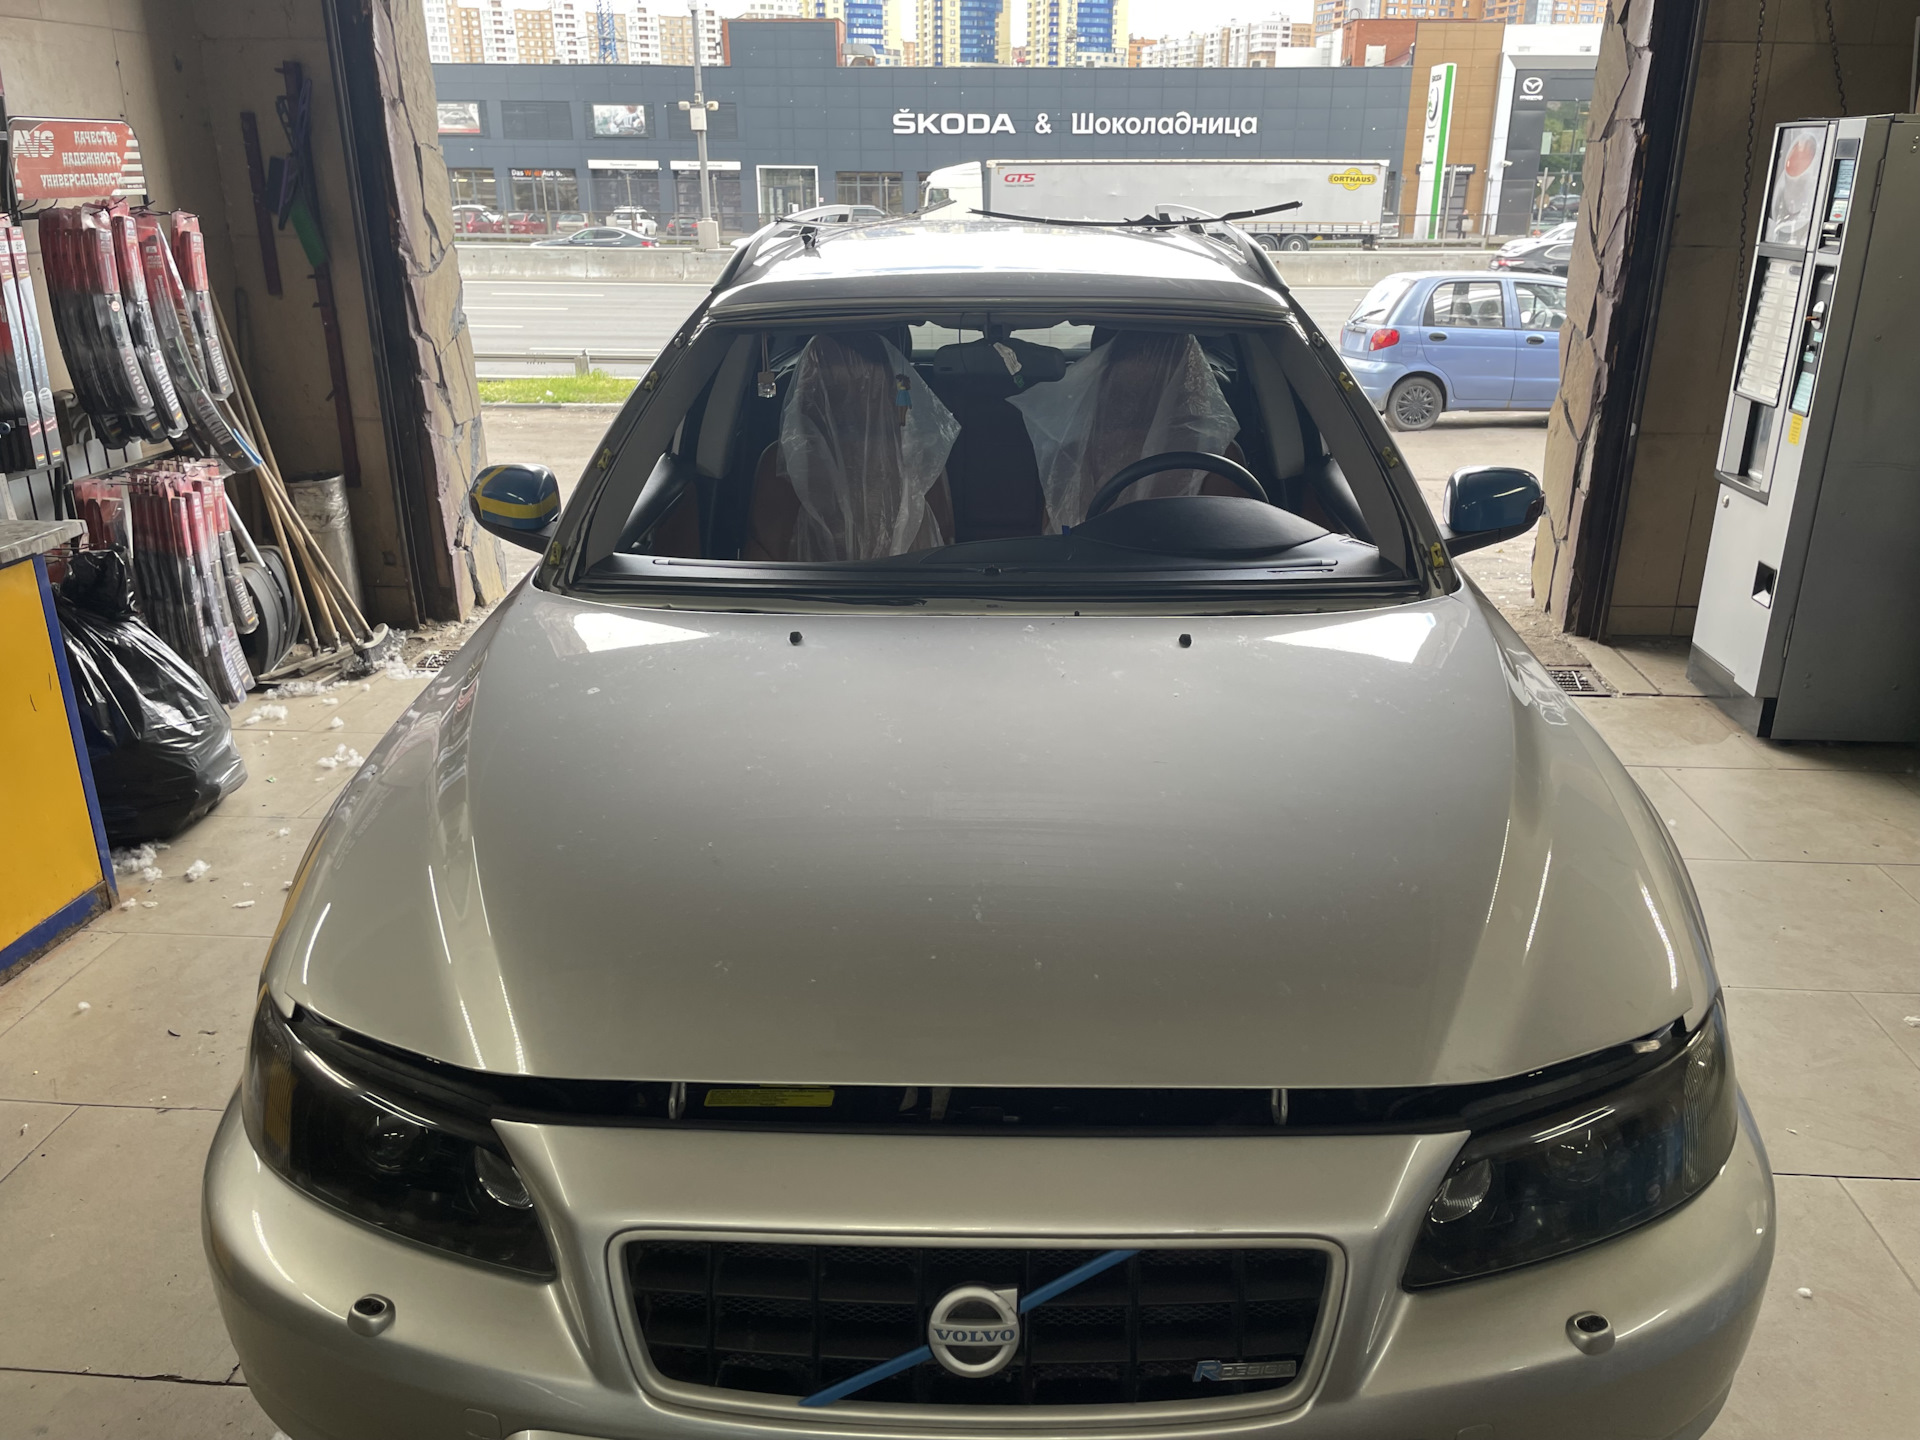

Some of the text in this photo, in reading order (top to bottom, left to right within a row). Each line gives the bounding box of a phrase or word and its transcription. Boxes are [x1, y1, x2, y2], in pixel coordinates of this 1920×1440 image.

[892, 108, 1258, 137] ŠKODA & Шоколадница
[12, 130, 54, 158] AVS
[73, 131, 118, 146] КАЧЕСТВО
[62, 152, 122, 167] НАДЕЖНОСТЬ
[1004, 173, 1036, 183] GTS
[1333, 175, 1372, 183] ORTHAUS
[934, 1329, 1015, 1342] VOLVO
